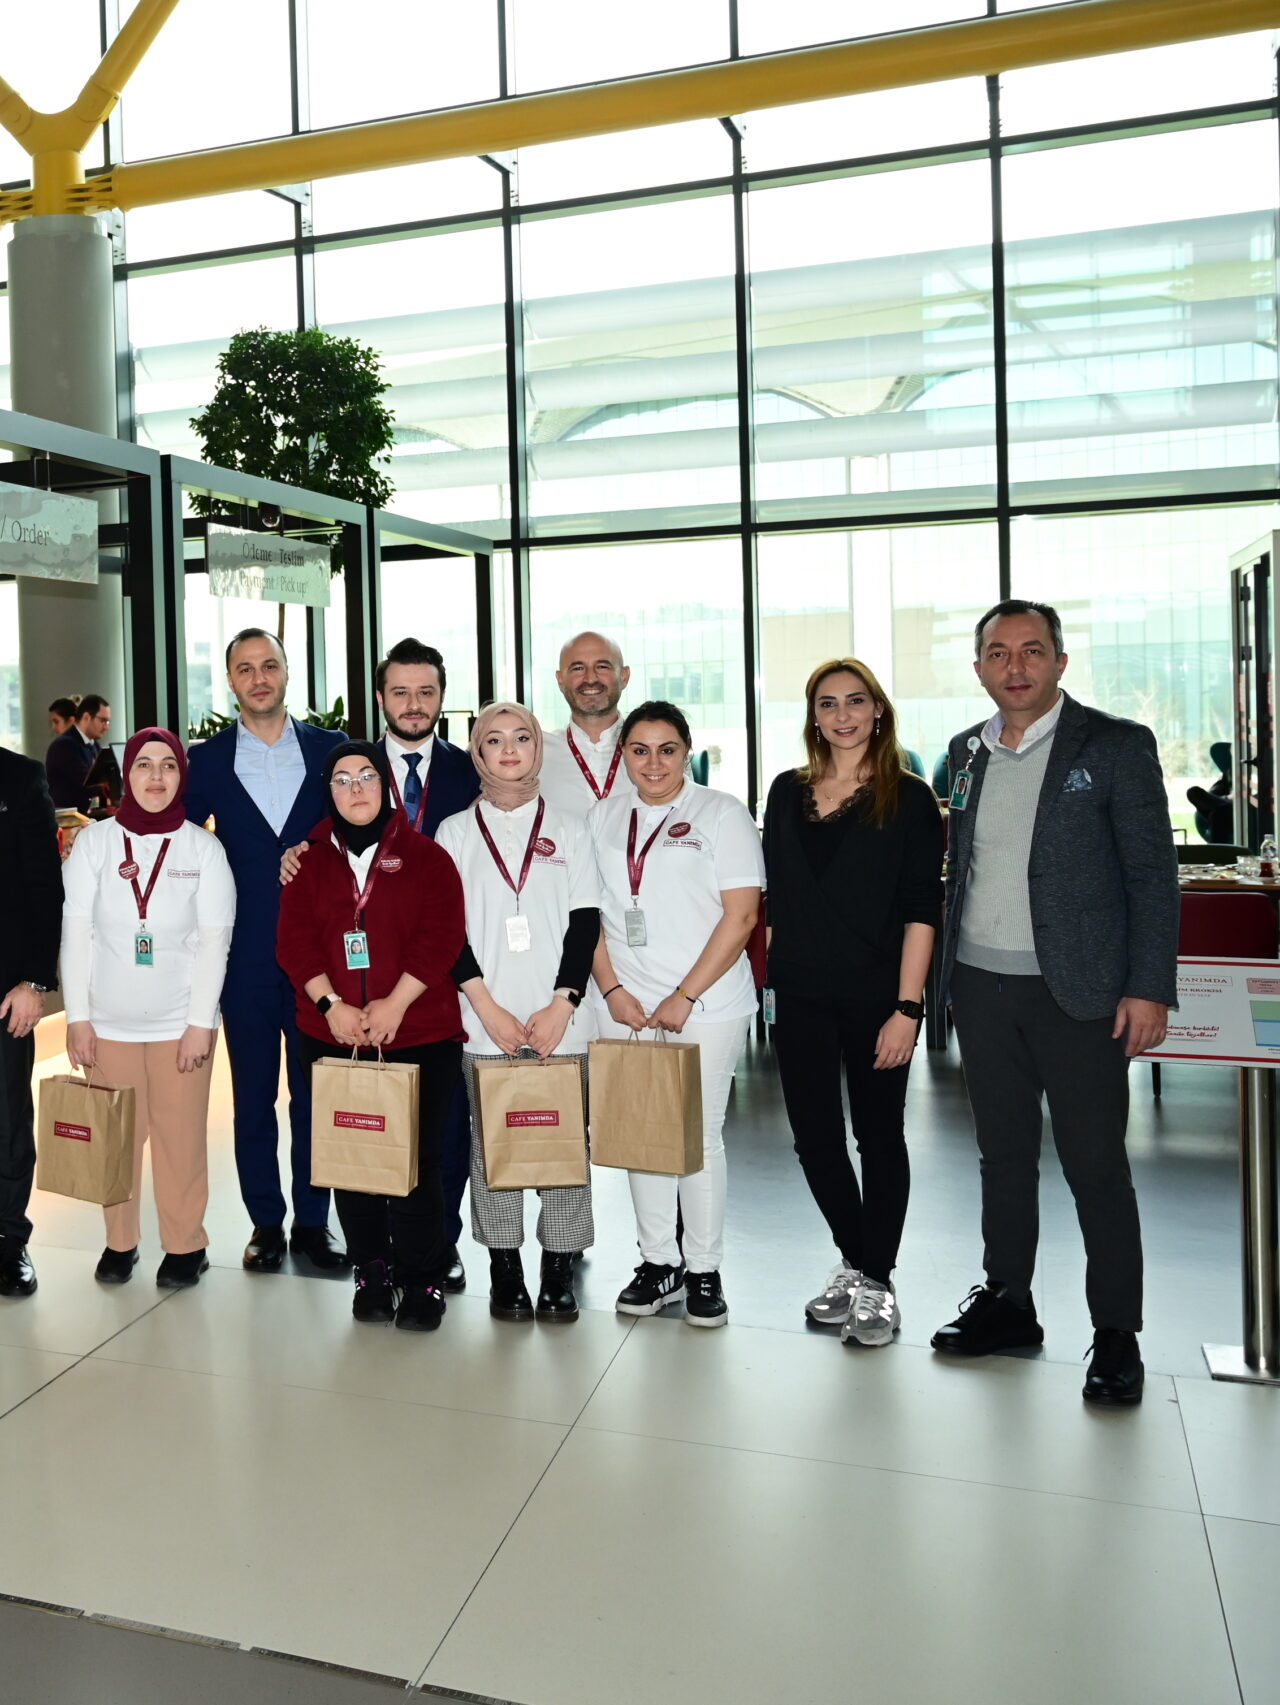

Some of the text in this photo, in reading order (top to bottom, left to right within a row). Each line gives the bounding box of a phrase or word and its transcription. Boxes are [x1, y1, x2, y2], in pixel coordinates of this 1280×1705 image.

[11, 520, 50, 546] Order
[279, 547, 305, 567] Teslim
[1177, 977, 1228, 985] YANIMDA
[355, 1118, 381, 1126] YANIMDA
